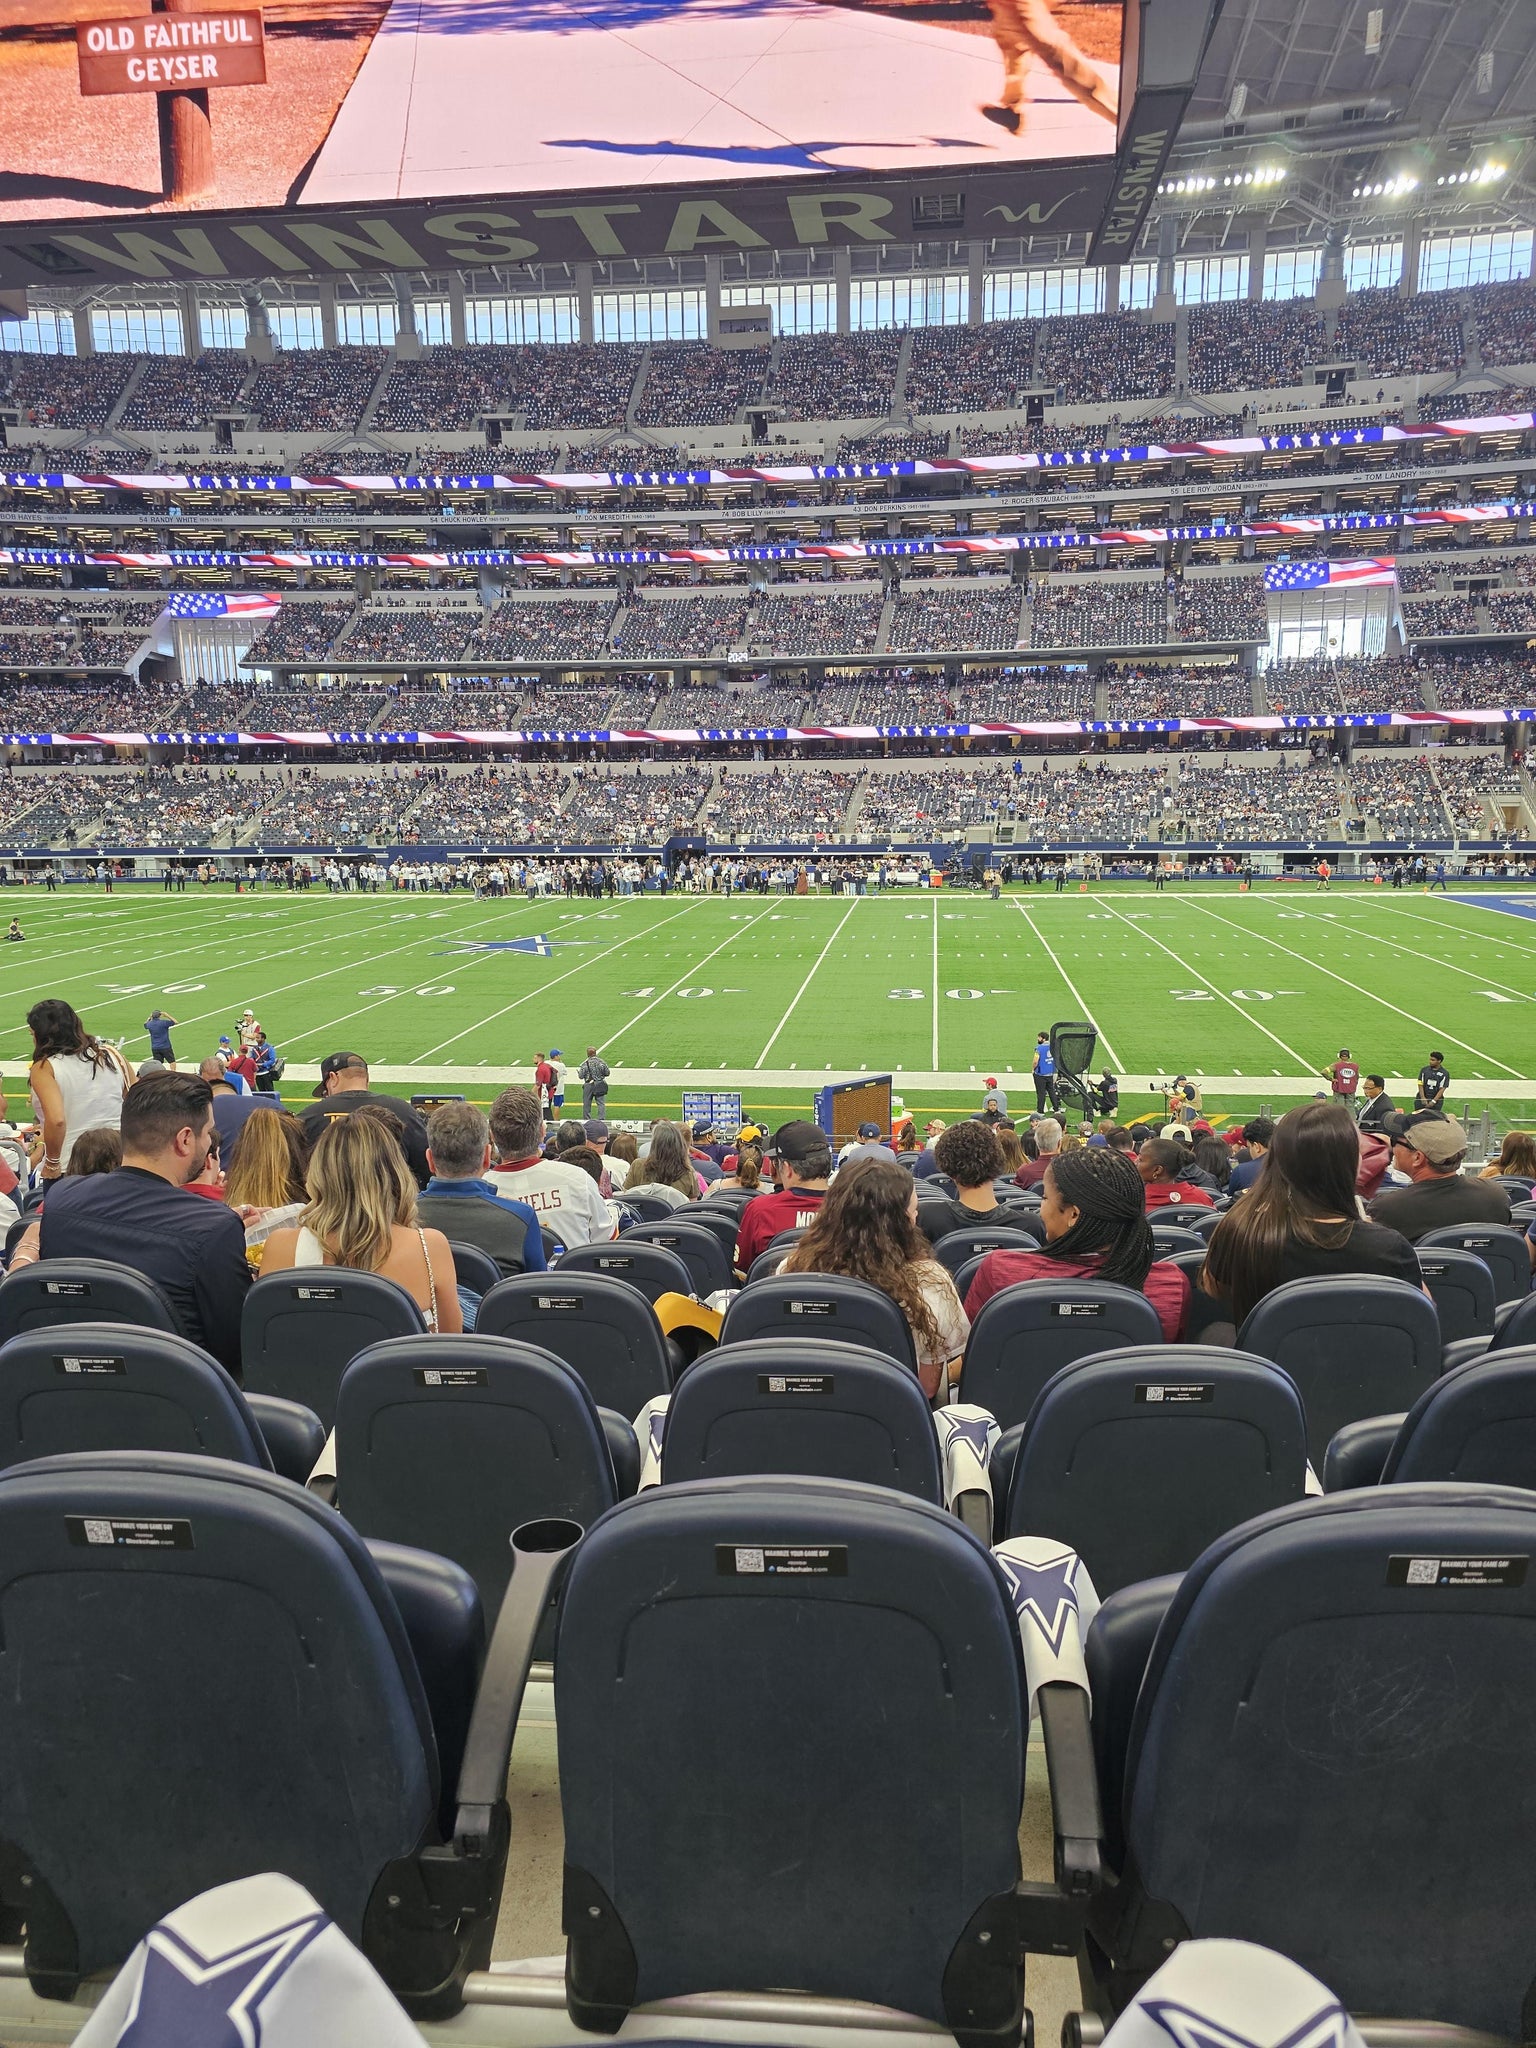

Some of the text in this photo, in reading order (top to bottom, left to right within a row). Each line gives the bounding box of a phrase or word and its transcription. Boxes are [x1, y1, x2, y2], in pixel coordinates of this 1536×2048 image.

[87, 18, 253, 52] OLD FAITHFUL
[127, 54, 219, 82] GEYSER
[1102, 129, 1168, 245] WINSTAR
[50, 192, 897, 278] WINSTAR
[1385, 471, 1417, 479] LANDRY
[1213, 484, 1242, 492] JORDAN
[1035, 495, 1070, 503] STAUBACH
[727, 652, 748, 662] 20:29
[107, 984, 207, 994] 40
[356, 985, 456, 996] 50
[618, 987, 715, 998] 40
[886, 988, 986, 1000] 30
[1168, 989, 1275, 1001] 20
[1470, 990, 1536, 1002] 1
